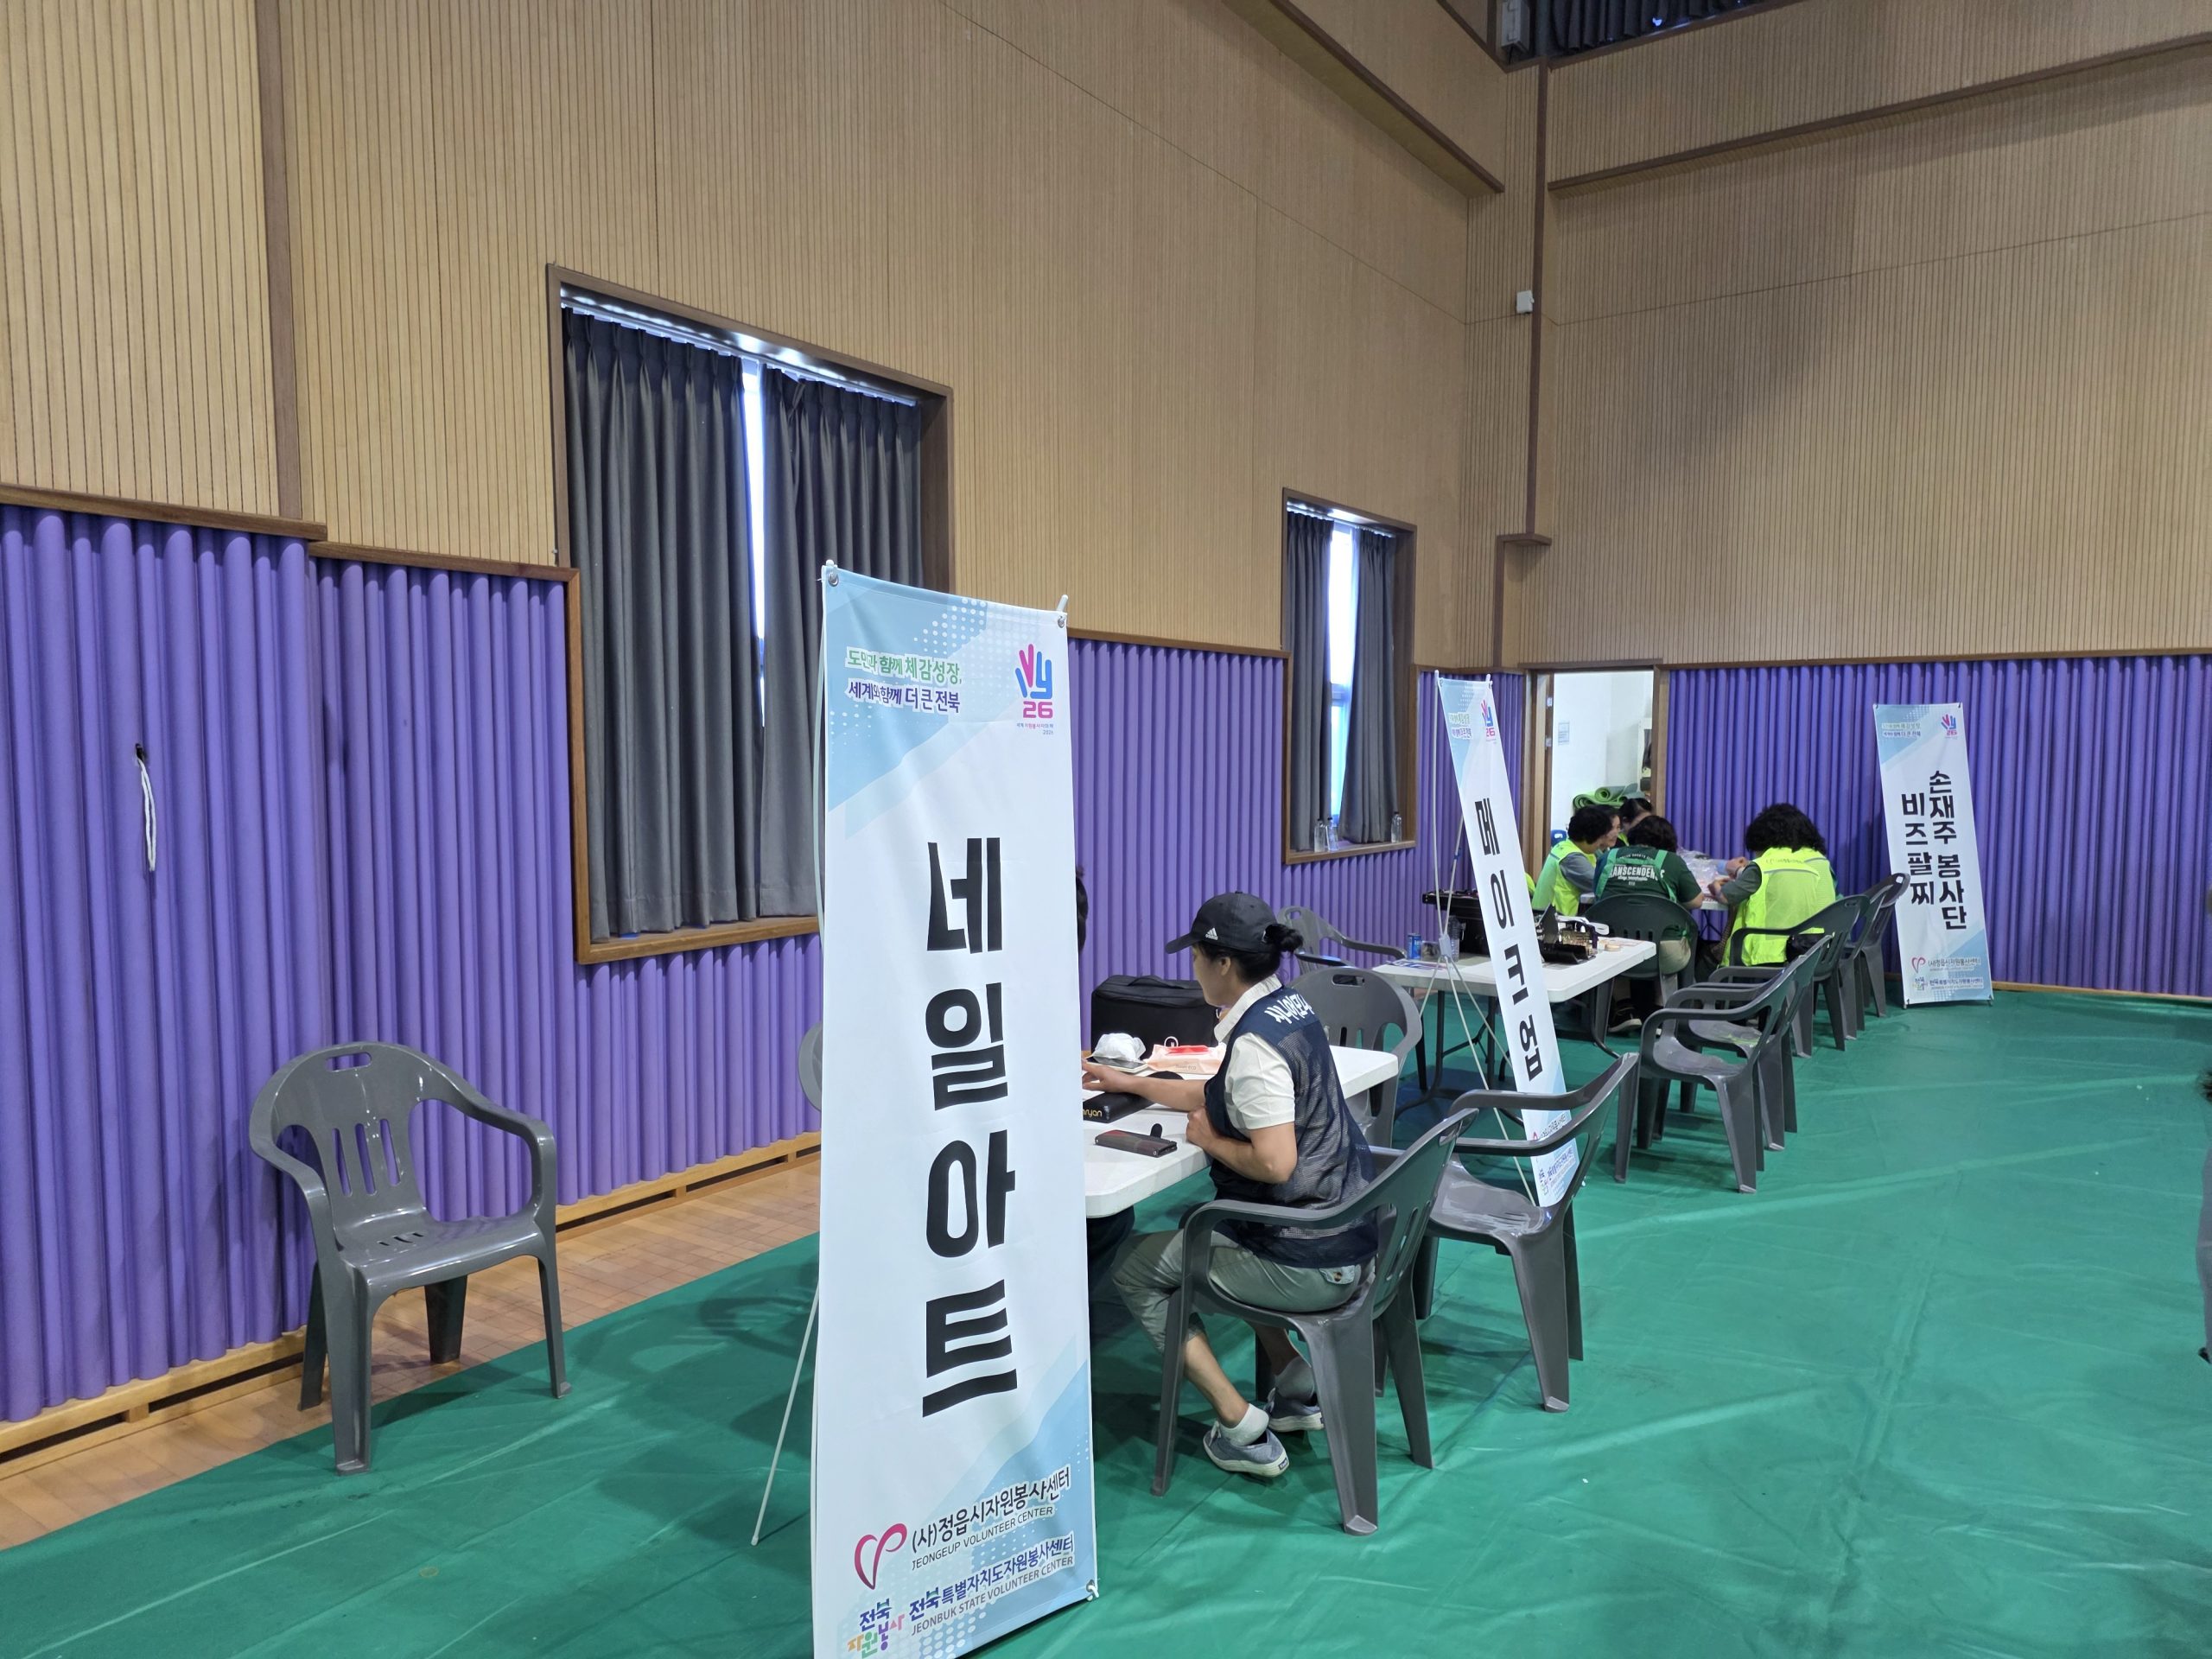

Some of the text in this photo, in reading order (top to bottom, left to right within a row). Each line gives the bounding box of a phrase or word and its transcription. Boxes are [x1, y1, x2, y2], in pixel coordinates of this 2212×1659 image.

[849, 682, 961, 714] 세계와 함께 더 큰 전북
[880, 656, 903, 675] 함께
[1023, 701, 1053, 719] 26
[1929, 770, 1957, 845] 손재주
[1938, 854, 1967, 931] 봉사단
[1474, 798, 1543, 1082] 메이크업
[923, 837, 1018, 1418] 네일아트
[912, 1466, 1070, 1554] (사)정읍시자원봉사센터
[912, 1506, 1053, 1571] JEONGEUP VOLUNTEER CENTER
[859, 1598, 893, 1632] 전북
[909, 1534, 1074, 1622] 전북특별자치도자원봉사센터
[912, 1556, 1073, 1636] JEONBUK STATE VOLUNTEER CENTER
